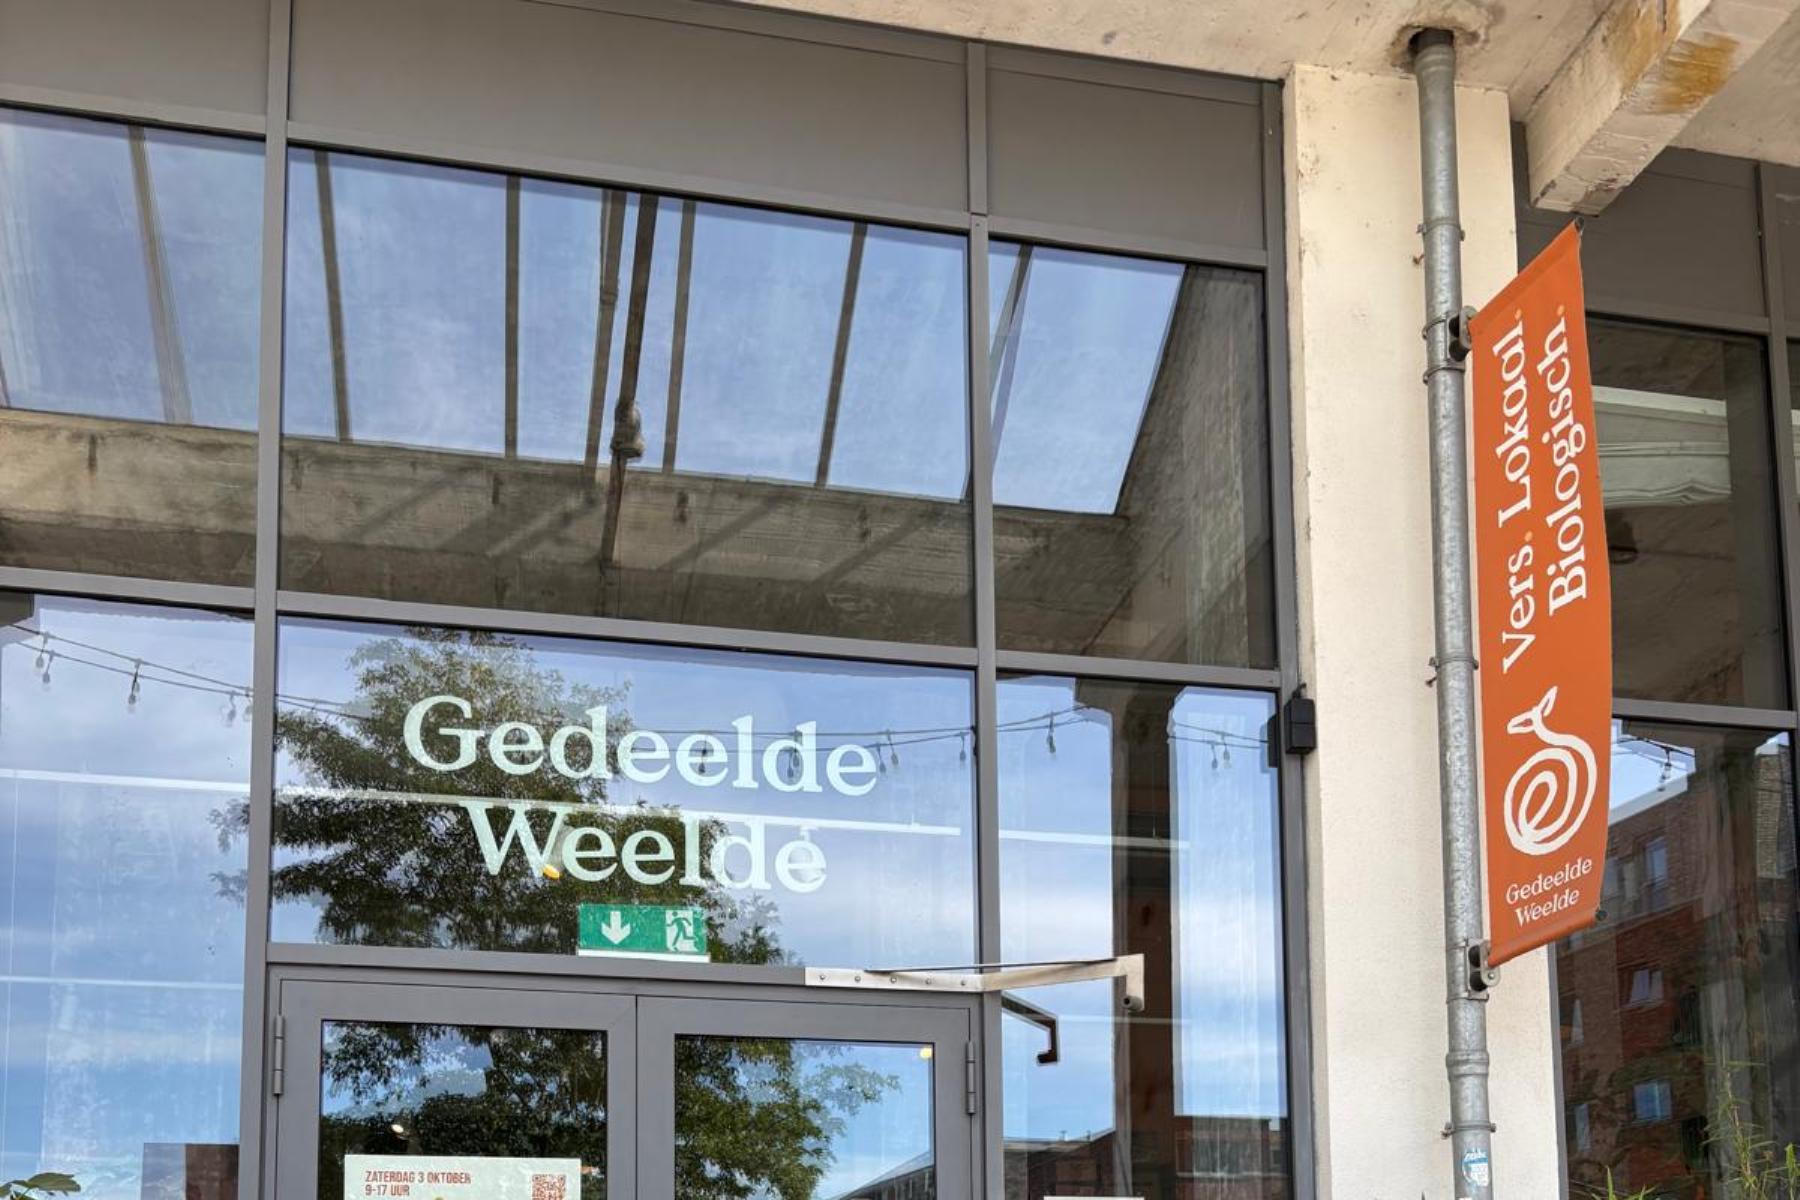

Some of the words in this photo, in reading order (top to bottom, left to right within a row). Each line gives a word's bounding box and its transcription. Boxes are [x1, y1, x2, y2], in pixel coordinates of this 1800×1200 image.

[1492, 308, 1532, 528] Lokaal.
[1536, 304, 1587, 616] Biologisch.
[1502, 531, 1536, 674] Vers.
[403, 695, 878, 796] Gedeelde
[459, 801, 828, 893] Weelde
[1506, 856, 1593, 905] Gedeelde
[1515, 888, 1580, 928] Weelde
[365, 1171, 415, 1183] ZATERDAG
[417, 1172, 424, 1183] 3
[427, 1172, 471, 1184] OKTOBER
[365, 1185, 387, 1196] 9-17
[391, 1185, 410, 1196] UUR
